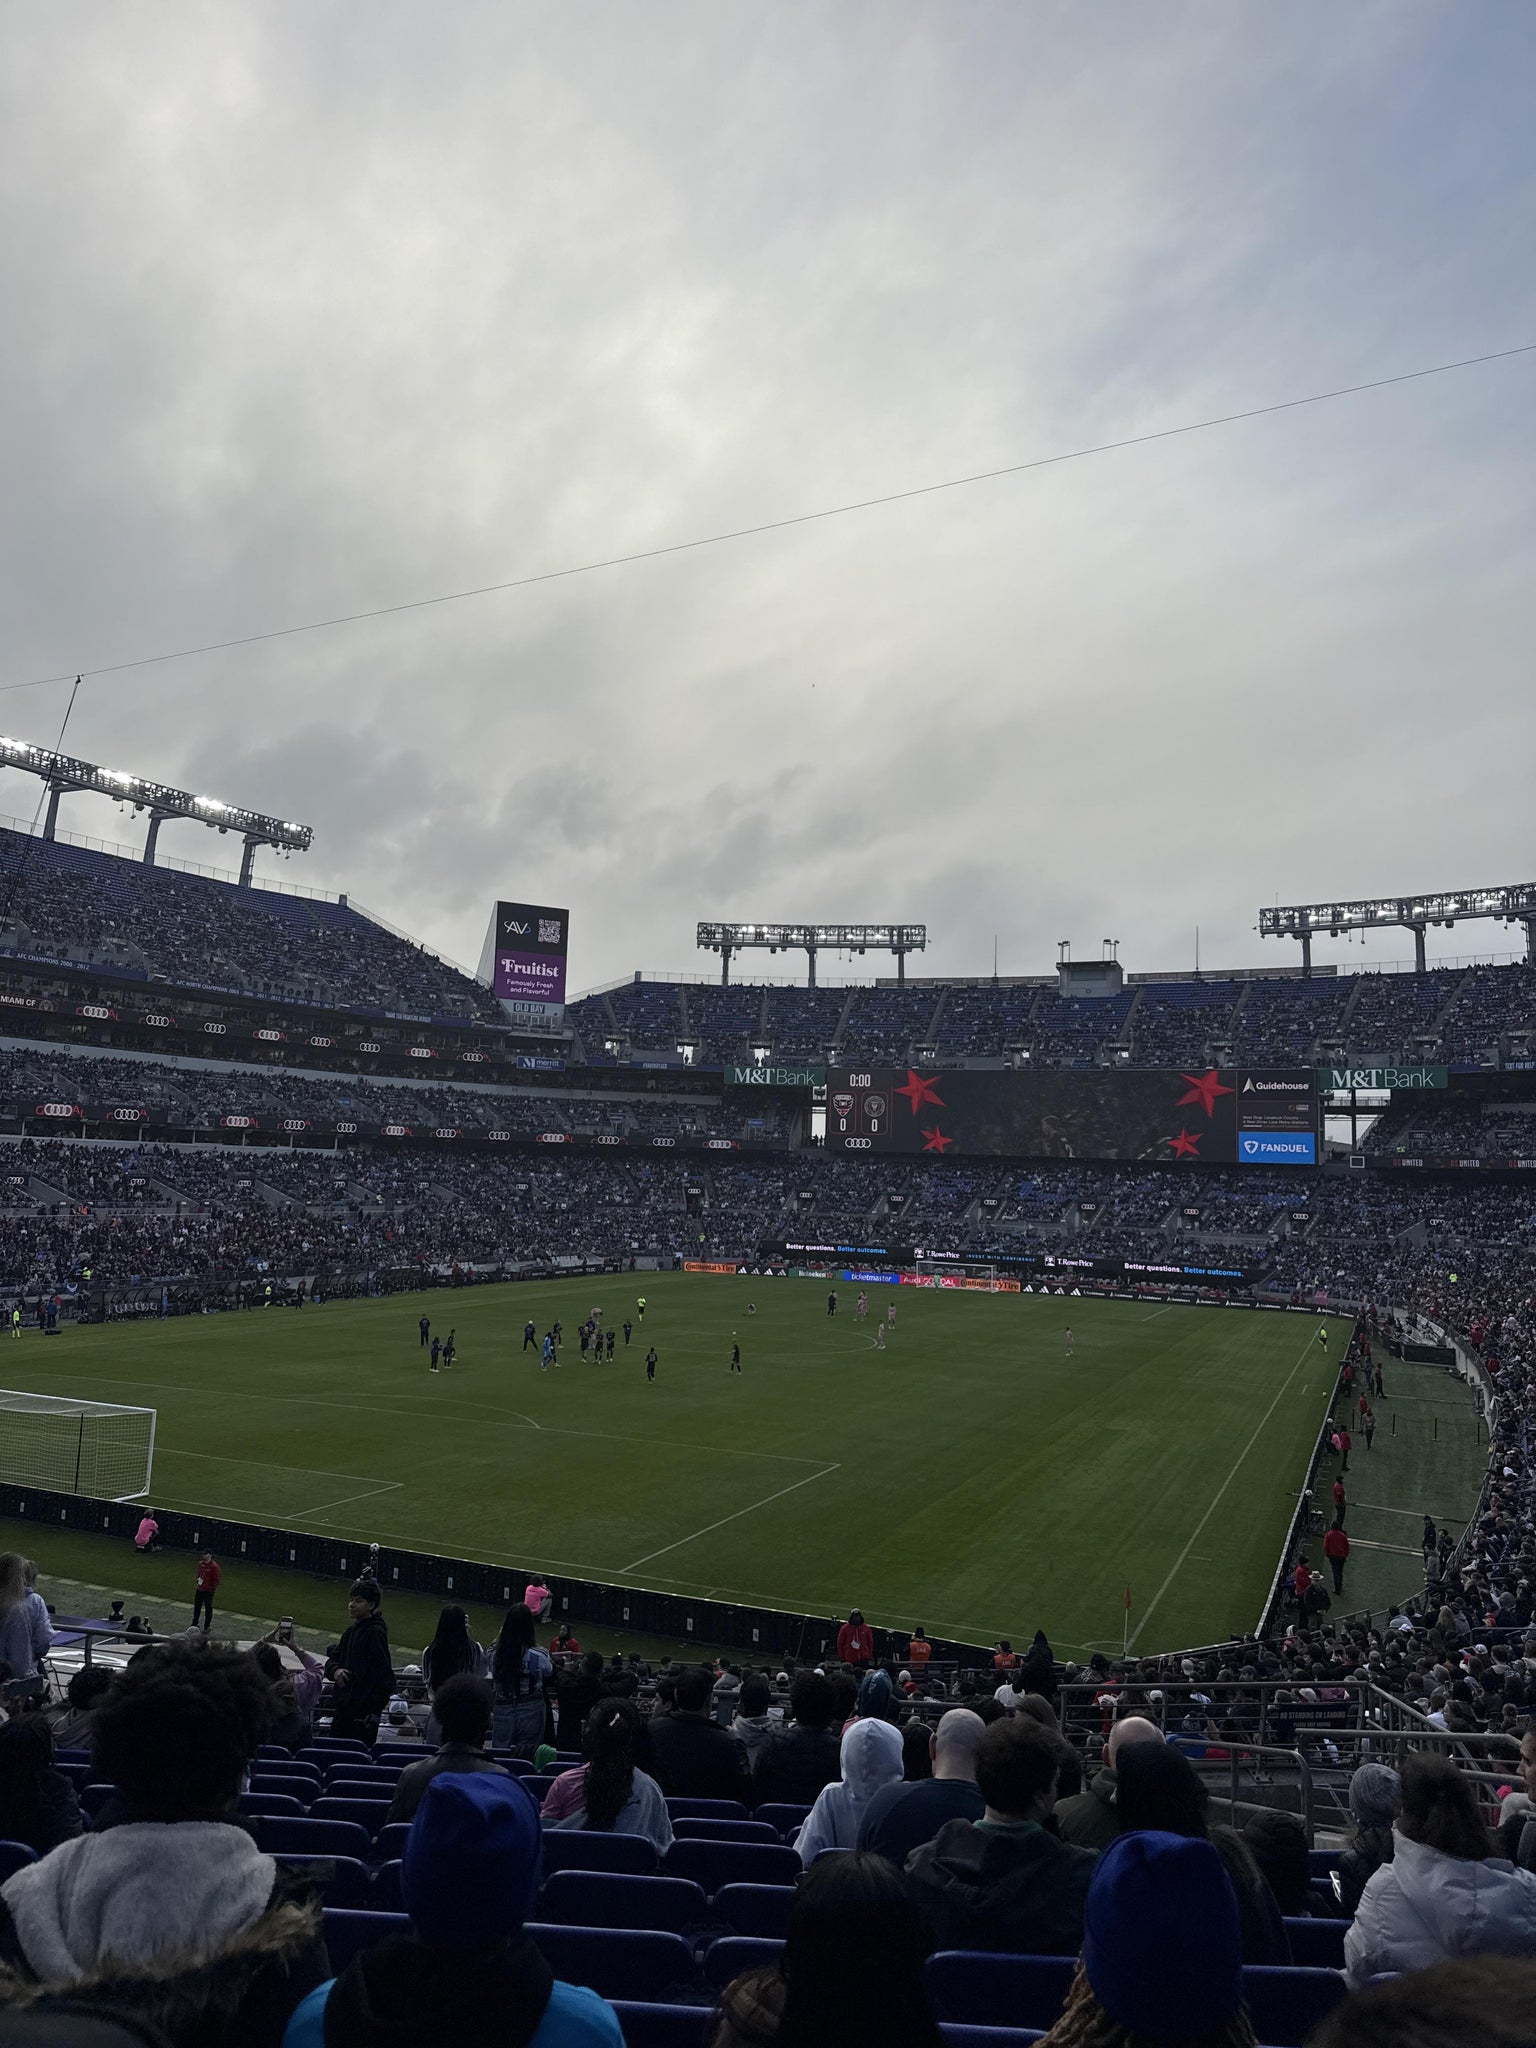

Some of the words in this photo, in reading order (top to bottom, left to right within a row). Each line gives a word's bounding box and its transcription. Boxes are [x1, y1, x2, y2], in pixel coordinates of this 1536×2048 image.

[28, 955, 59, 966] CHAMPIONS
[501, 958, 560, 978] Fruitist
[507, 979, 535, 989] Famously
[536, 981, 554, 989] Fresh
[522, 988, 550, 996] Flavorful
[0, 995, 25, 1006] MIAMI
[515, 1003, 529, 1012] OLD
[530, 1005, 545, 1014] BAY
[734, 1067, 775, 1085] M&T
[776, 1068, 815, 1085] Bank
[850, 1074, 871, 1087] 0:00
[1330, 1069, 1384, 1089] M&T
[1384, 1068, 1434, 1088] Bank
[1255, 1081, 1310, 1090] Guidehouse
[839, 1118, 847, 1132] 0
[871, 1119, 878, 1132] 0
[1260, 1143, 1310, 1153] FANDUEL
[1401, 1159, 1423, 1167] UNITED
[1459, 1159, 1480, 1168] UNITED
[786, 1243, 804, 1251] Better
[806, 1244, 836, 1252] questions.
[837, 1245, 856, 1253] Better
[857, 1247, 889, 1255] outcomes.
[685, 1262, 717, 1271] Continental
[720, 1264, 736, 1273] Tire
[1124, 1262, 1145, 1271] Better
[1146, 1264, 1183, 1273] questions.
[1184, 1266, 1205, 1274] Better
[1207, 1269, 1244, 1278] outcomes.
[799, 1270, 827, 1278] Heineken
[851, 1273, 892, 1282] ticketmaster
[903, 1276, 921, 1284] Audi
[1003, 1280, 1019, 1290] Tire
